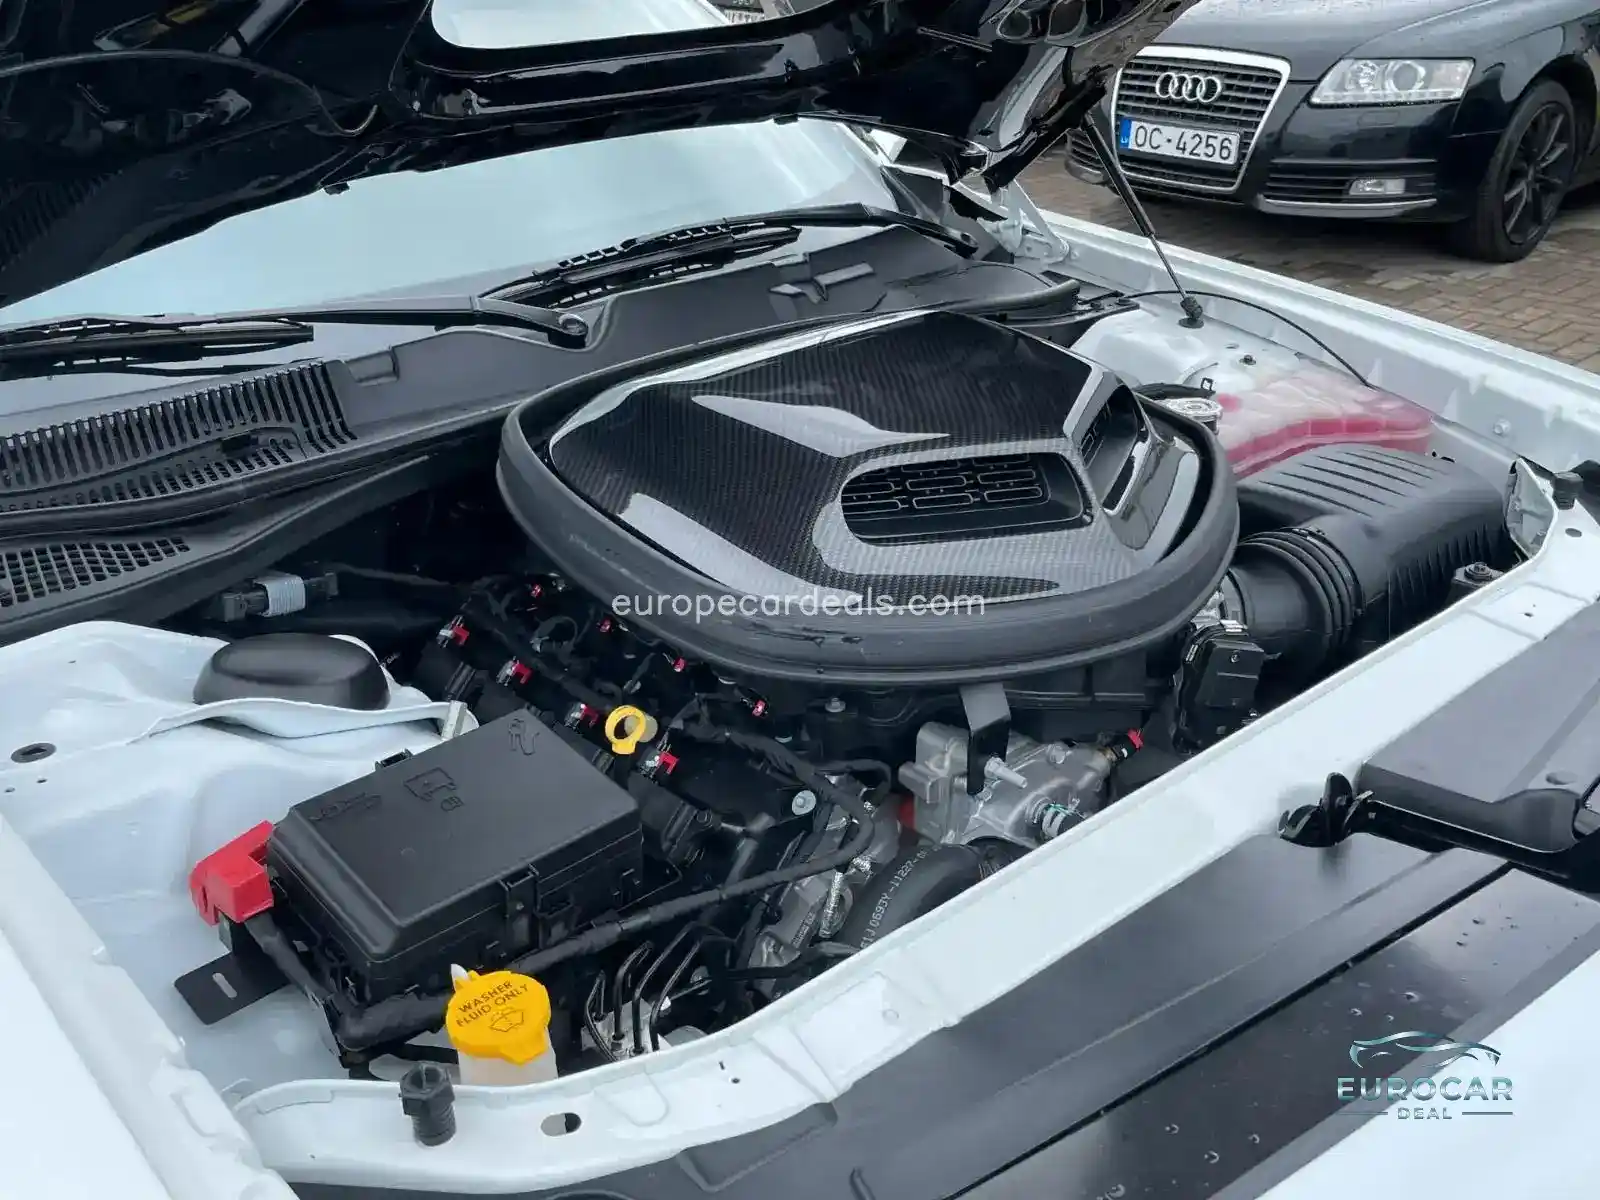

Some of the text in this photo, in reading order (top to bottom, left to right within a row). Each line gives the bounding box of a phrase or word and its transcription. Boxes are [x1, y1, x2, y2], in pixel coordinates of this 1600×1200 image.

[1135, 125, 1233, 160] OC-4256
[456, 984, 528, 1027] FLUID ONLY
[458, 980, 513, 1013] WASHER
